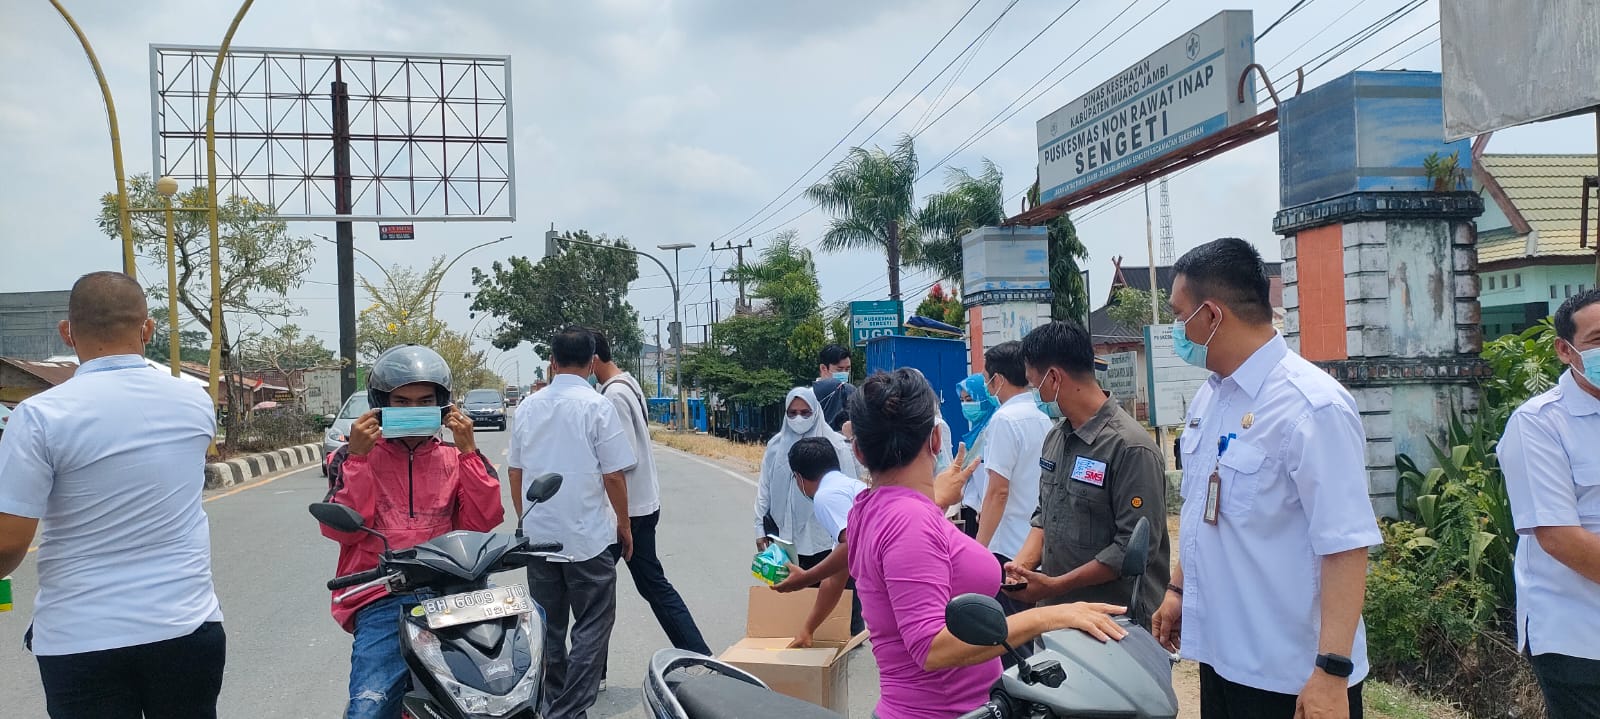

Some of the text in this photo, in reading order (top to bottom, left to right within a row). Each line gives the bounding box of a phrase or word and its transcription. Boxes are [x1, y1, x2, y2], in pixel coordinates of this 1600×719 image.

[1044, 63, 1213, 165] PUSKESMAS NON RAWAT INAP
[1070, 63, 1168, 128] KABUPATEN MUARO JAMBI
[1083, 60, 1149, 108] DINAS KESEHATAN
[1075, 109, 1167, 175] SENGETI
[426, 599, 448, 613] BH
[454, 592, 495, 609] 6009
